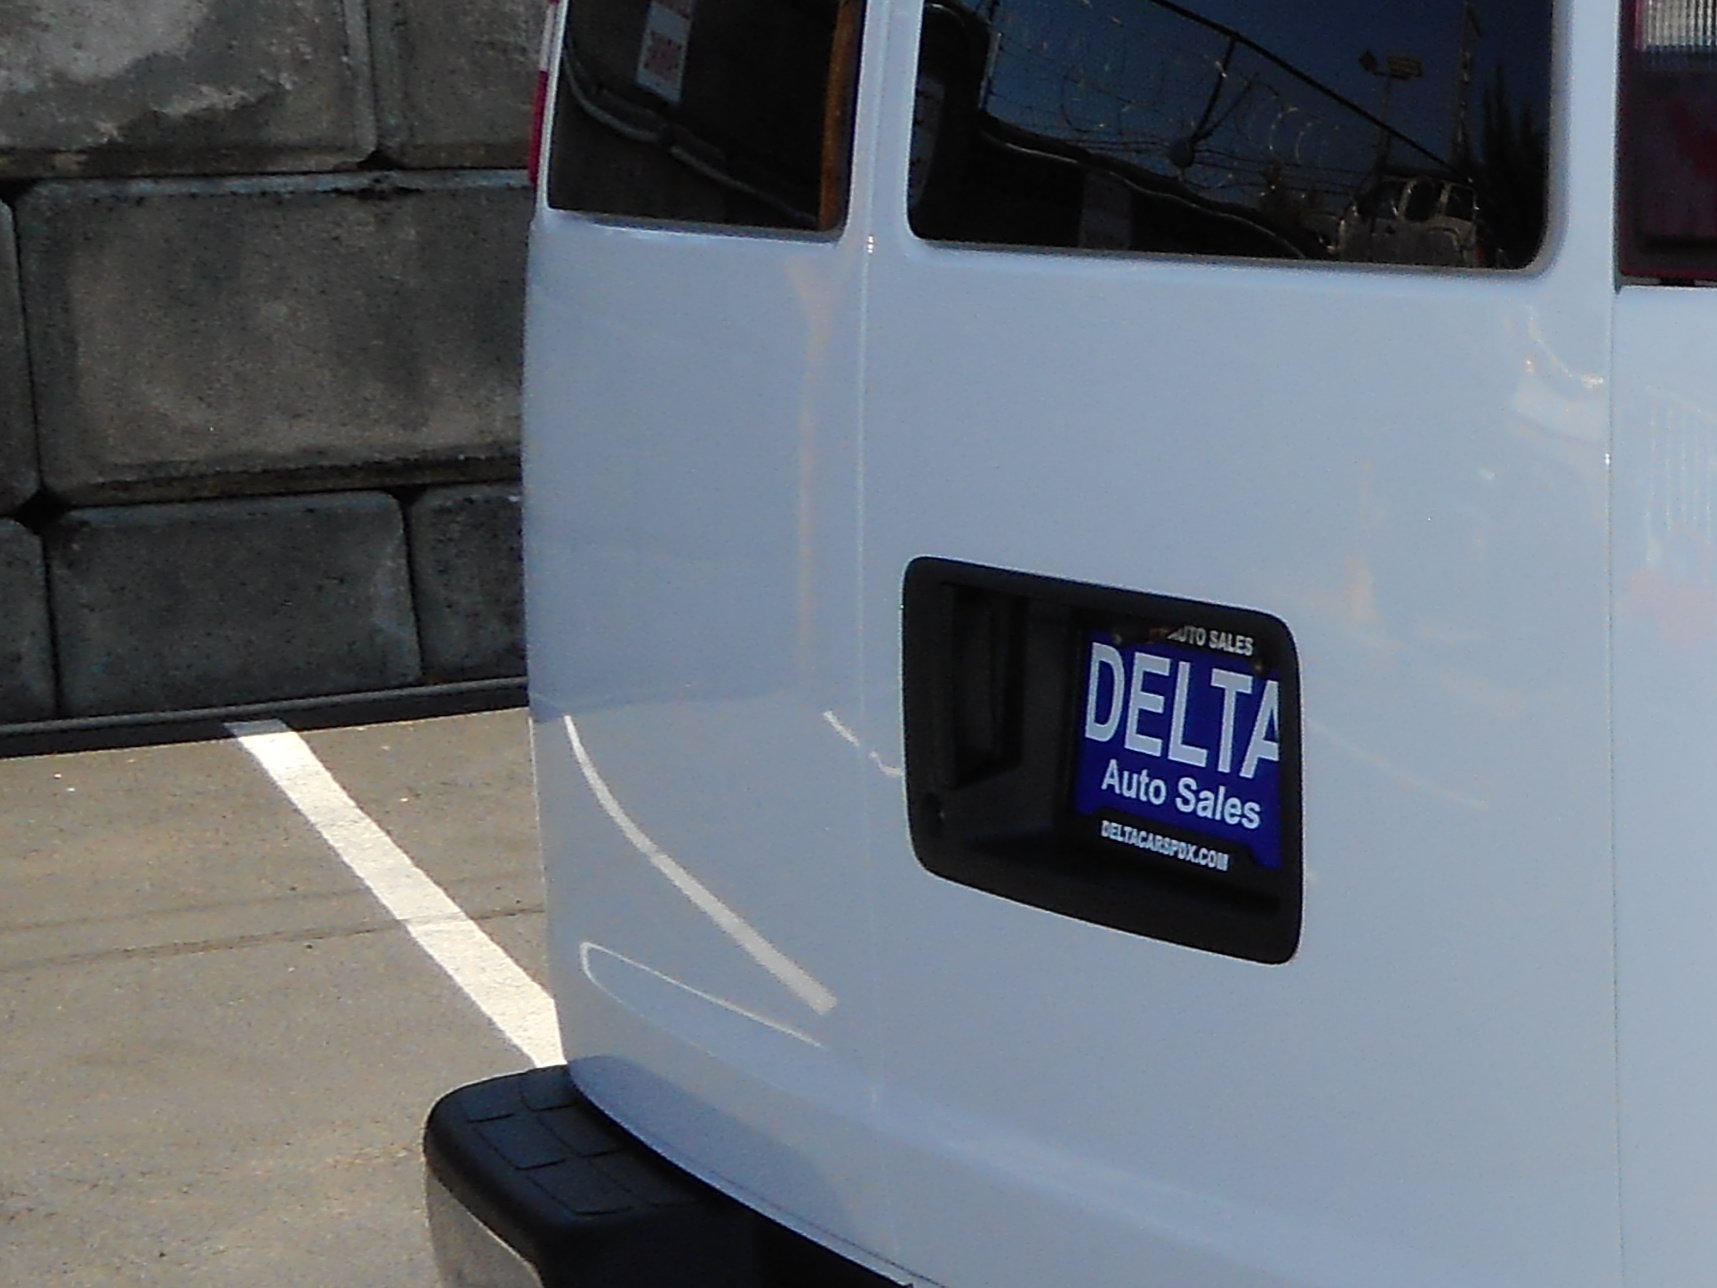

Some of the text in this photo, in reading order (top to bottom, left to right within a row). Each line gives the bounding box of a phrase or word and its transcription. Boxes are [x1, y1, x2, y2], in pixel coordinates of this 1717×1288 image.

[1208, 629, 1255, 657] SALES
[1084, 642, 1280, 779] DELTA
[1100, 758, 1261, 829] Auto Sales
[1100, 819, 1230, 872] DELTACARSPDX.COM
